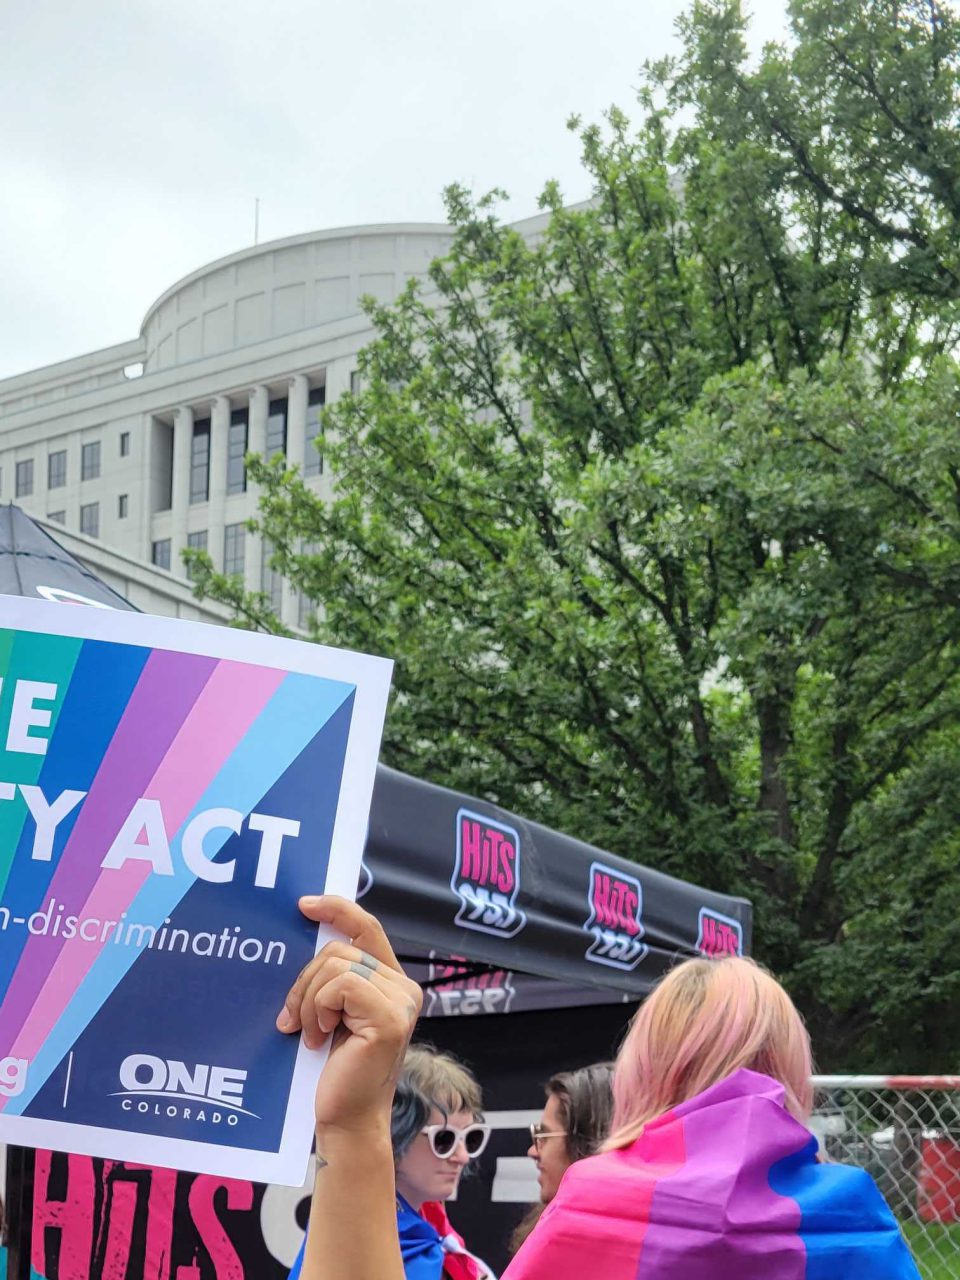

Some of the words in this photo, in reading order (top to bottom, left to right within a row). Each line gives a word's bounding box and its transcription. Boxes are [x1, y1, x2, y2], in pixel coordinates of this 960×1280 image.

[100, 797, 301, 890] ACT
[119, 1053, 248, 1107] ONE
[121, 1099, 239, 1126] COLORADO
